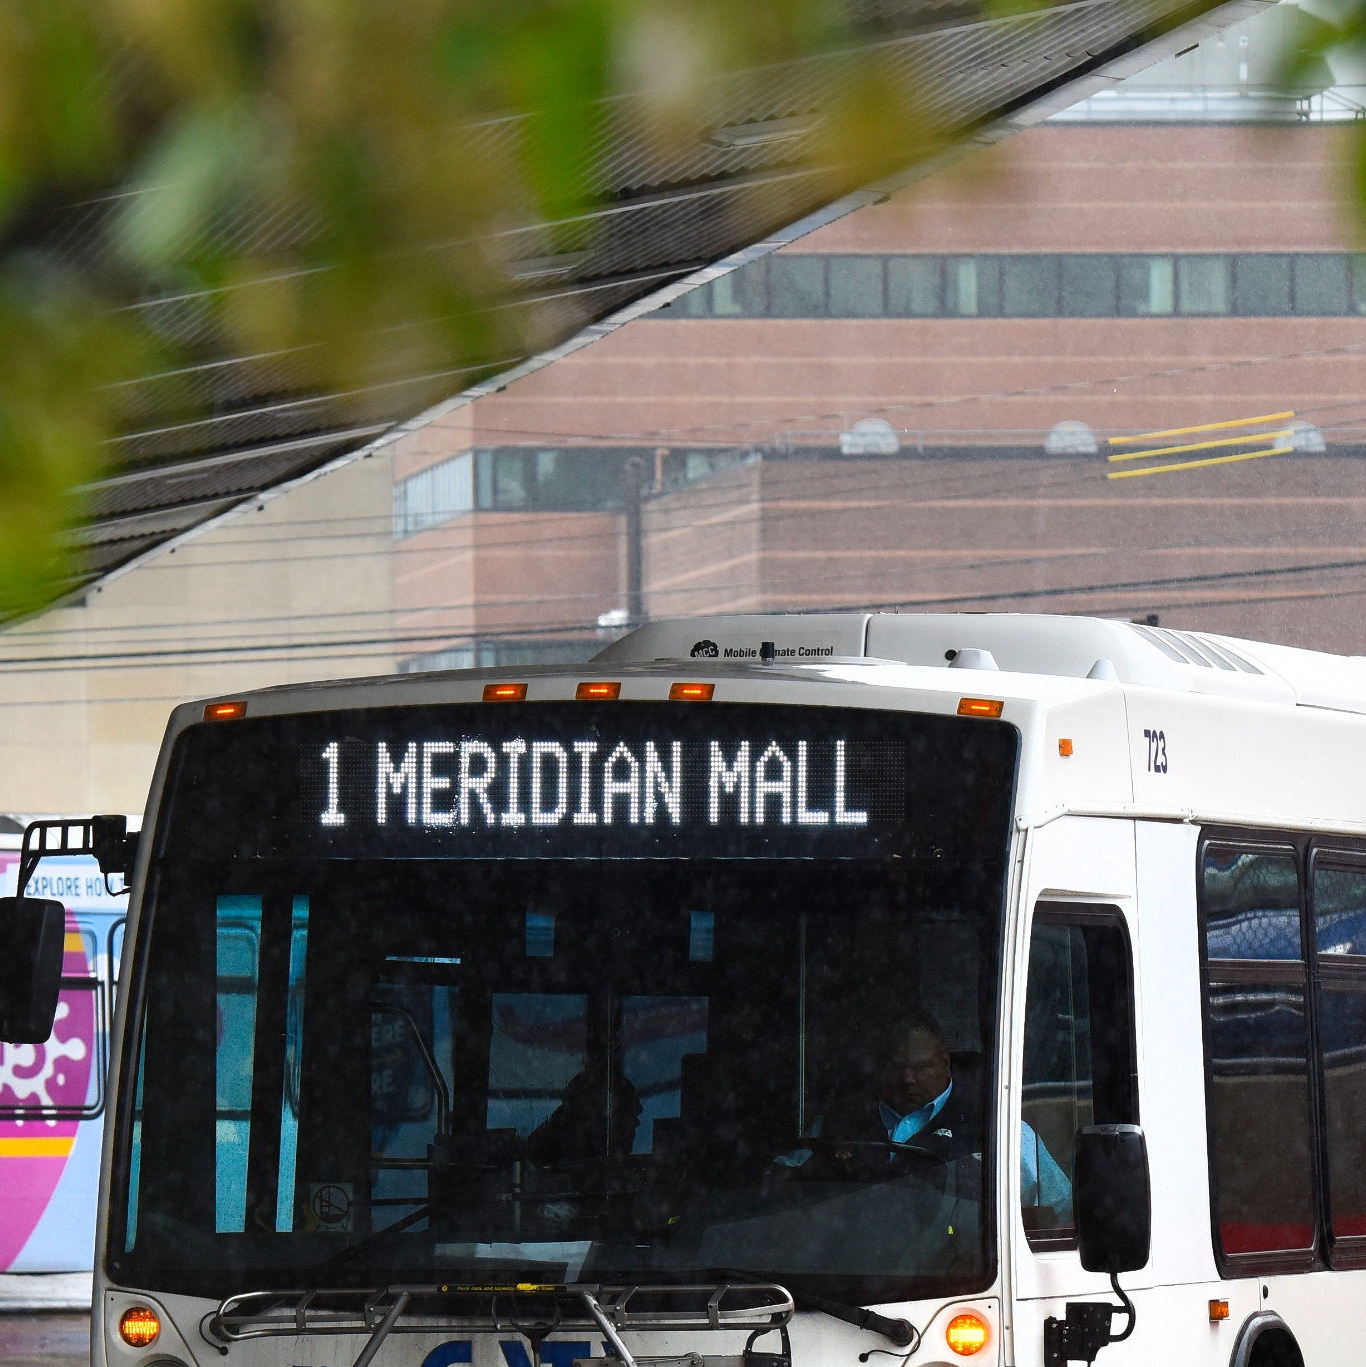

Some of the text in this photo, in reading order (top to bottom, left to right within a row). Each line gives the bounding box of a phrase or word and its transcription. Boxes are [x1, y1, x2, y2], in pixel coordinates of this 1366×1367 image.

[694, 646, 716, 658] MCC
[723, 647, 757, 658] Mobile
[798, 646, 834, 657] Control
[1144, 729, 1168, 775] 723
[321, 741, 869, 827] 1 MERIDIAN MALL
[25, 876, 81, 897] EXPLORE
